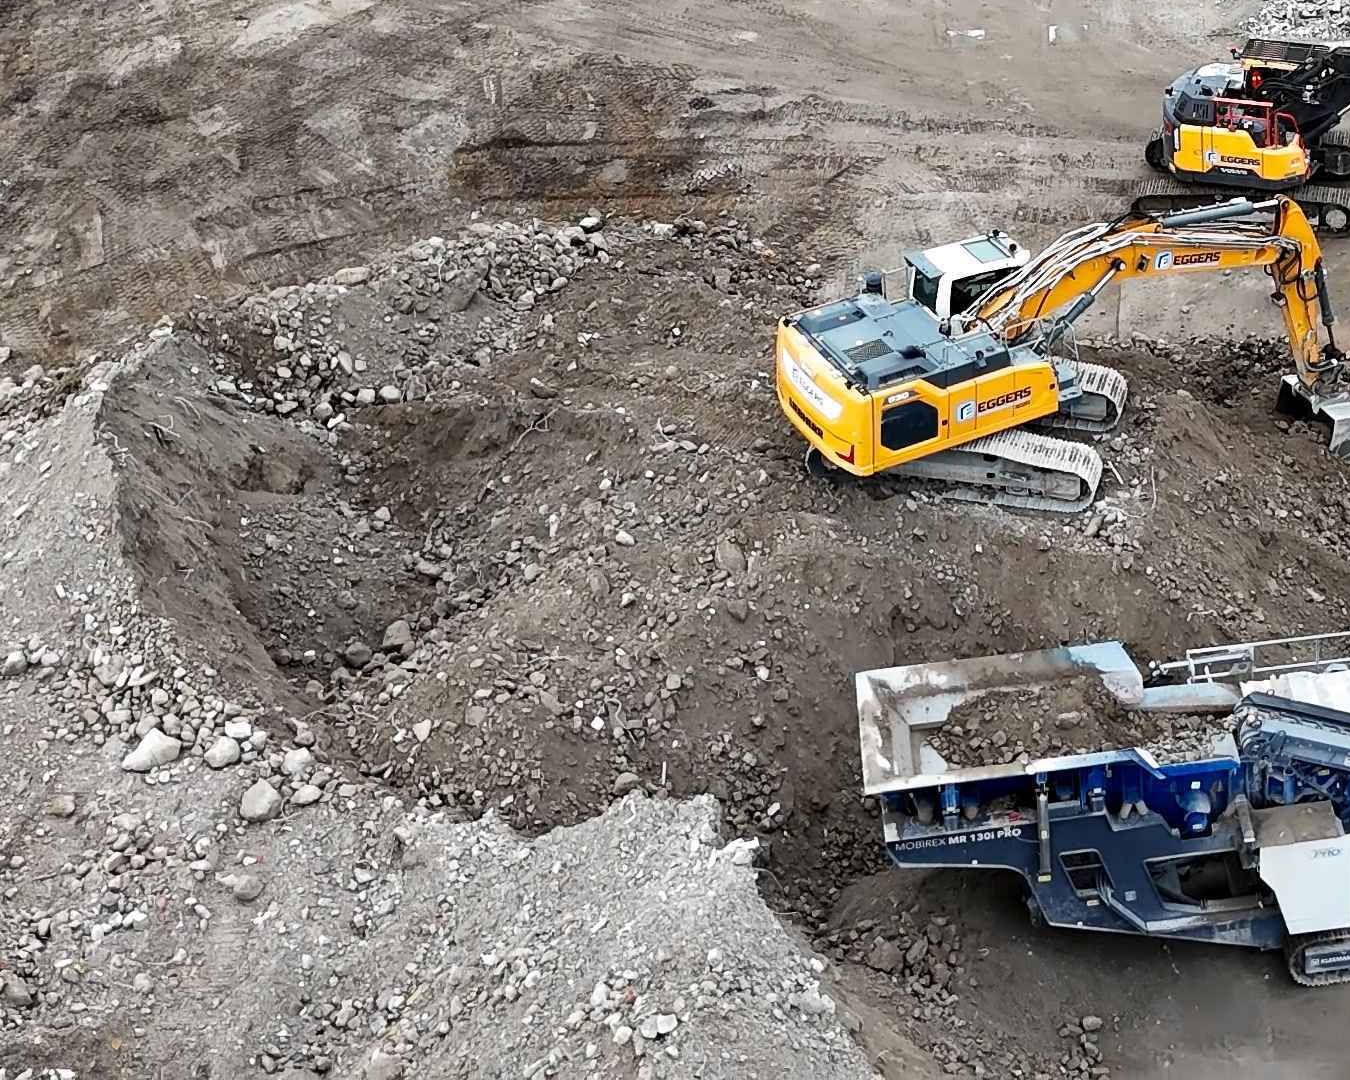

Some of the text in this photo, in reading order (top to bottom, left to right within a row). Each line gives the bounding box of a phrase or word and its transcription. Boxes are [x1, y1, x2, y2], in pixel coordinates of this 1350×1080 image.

[1220, 155, 1261, 166] EGGERS
[1172, 251, 1221, 266] EGGERS
[977, 386, 1032, 413] EGGERS
[895, 827, 1022, 852] MOBIREX MR 130i PRO
